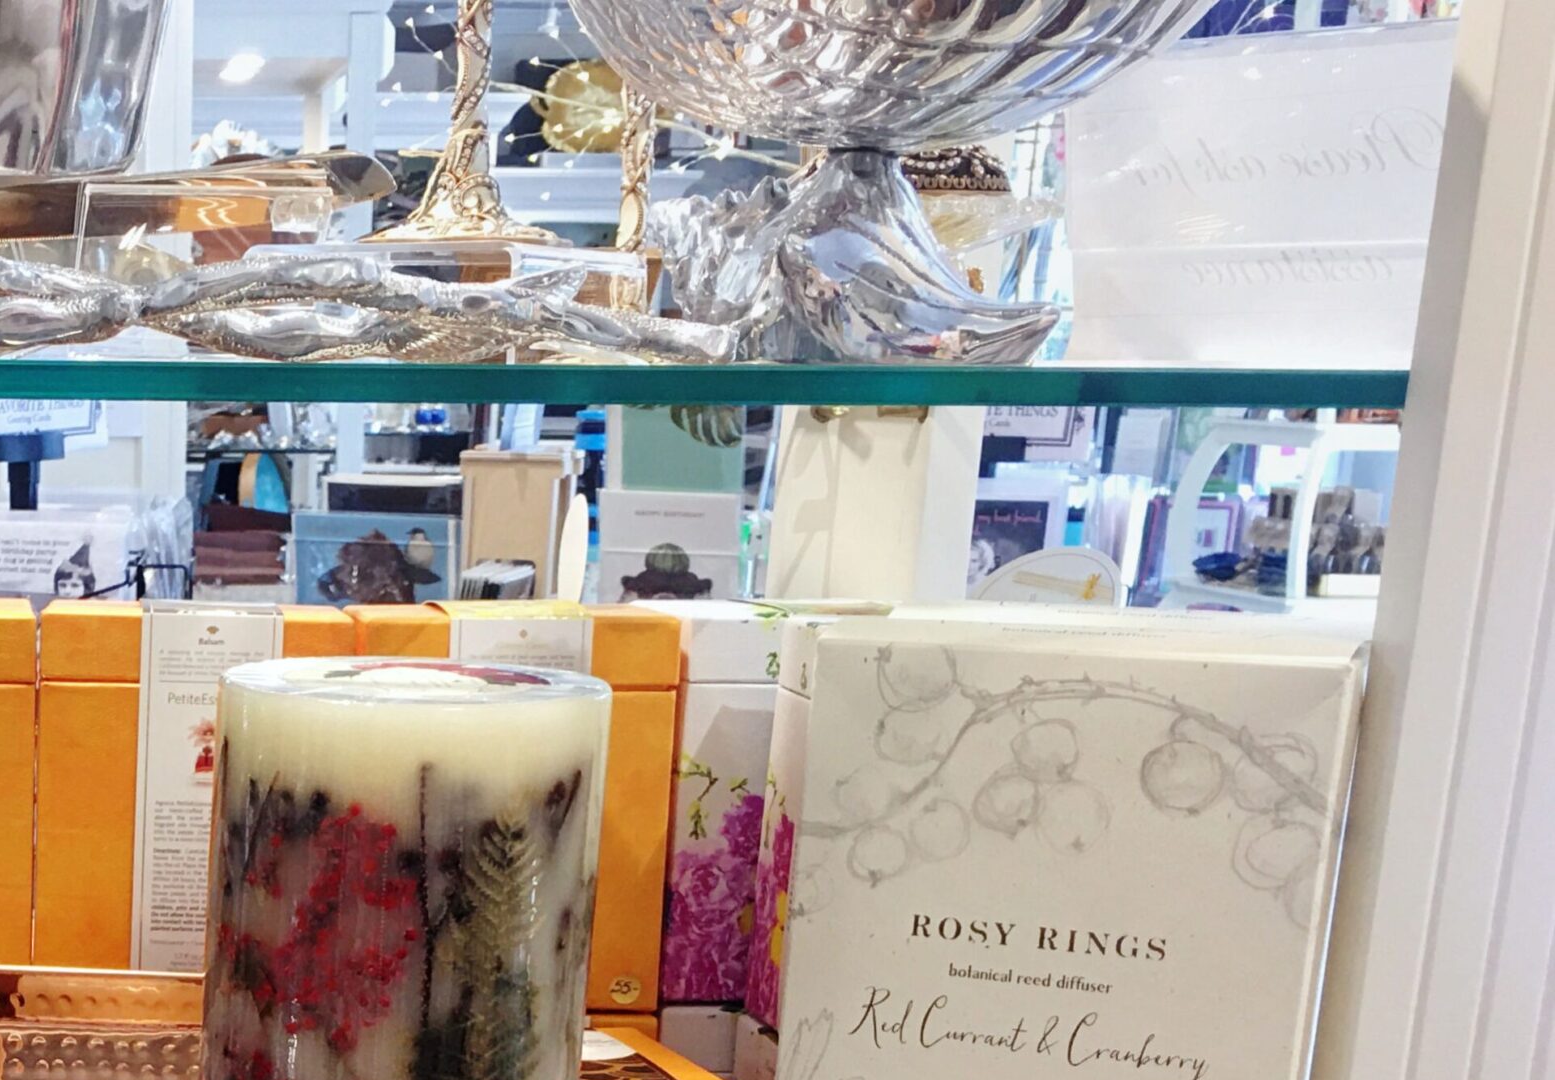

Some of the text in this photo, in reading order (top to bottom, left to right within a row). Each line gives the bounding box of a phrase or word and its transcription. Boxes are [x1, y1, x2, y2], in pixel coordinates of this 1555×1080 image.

[910, 914, 1167, 961] ROSY RINGS
[948, 963, 1113, 994] botanical reed diffuser
[848, 986, 913, 1049] Red
[919, 995, 1028, 1052] Currant
[1036, 1015, 1059, 1055] &
